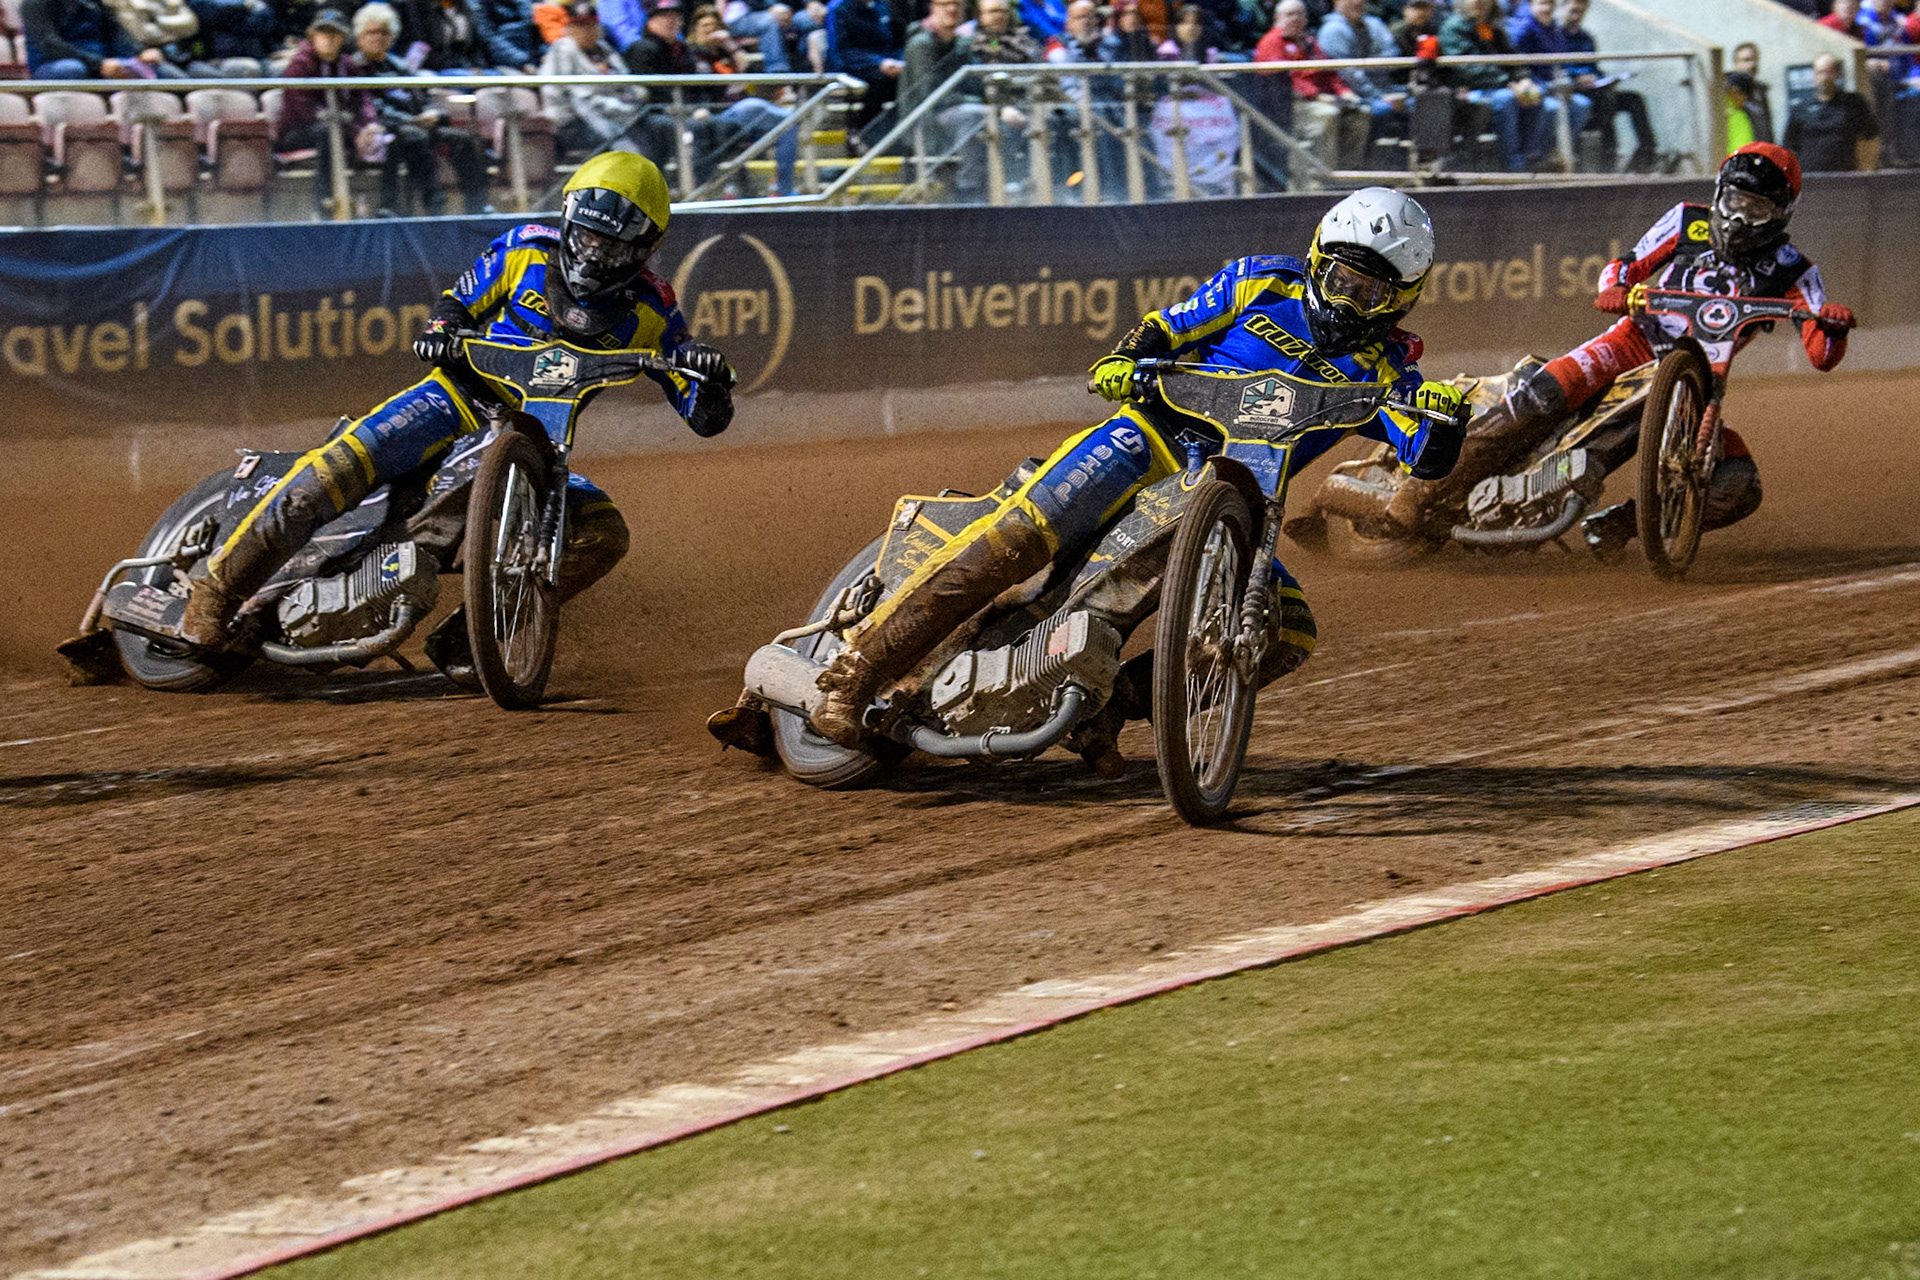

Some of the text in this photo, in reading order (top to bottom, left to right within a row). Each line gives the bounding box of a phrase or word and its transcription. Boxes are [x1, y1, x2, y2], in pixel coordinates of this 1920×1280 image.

[692, 288, 771, 341] ATPI
[853, 267, 1119, 341] Delivering
[0, 301, 150, 376] avel
[1053, 444, 1114, 503] PBHS
[1110, 527, 1136, 549] FORT
